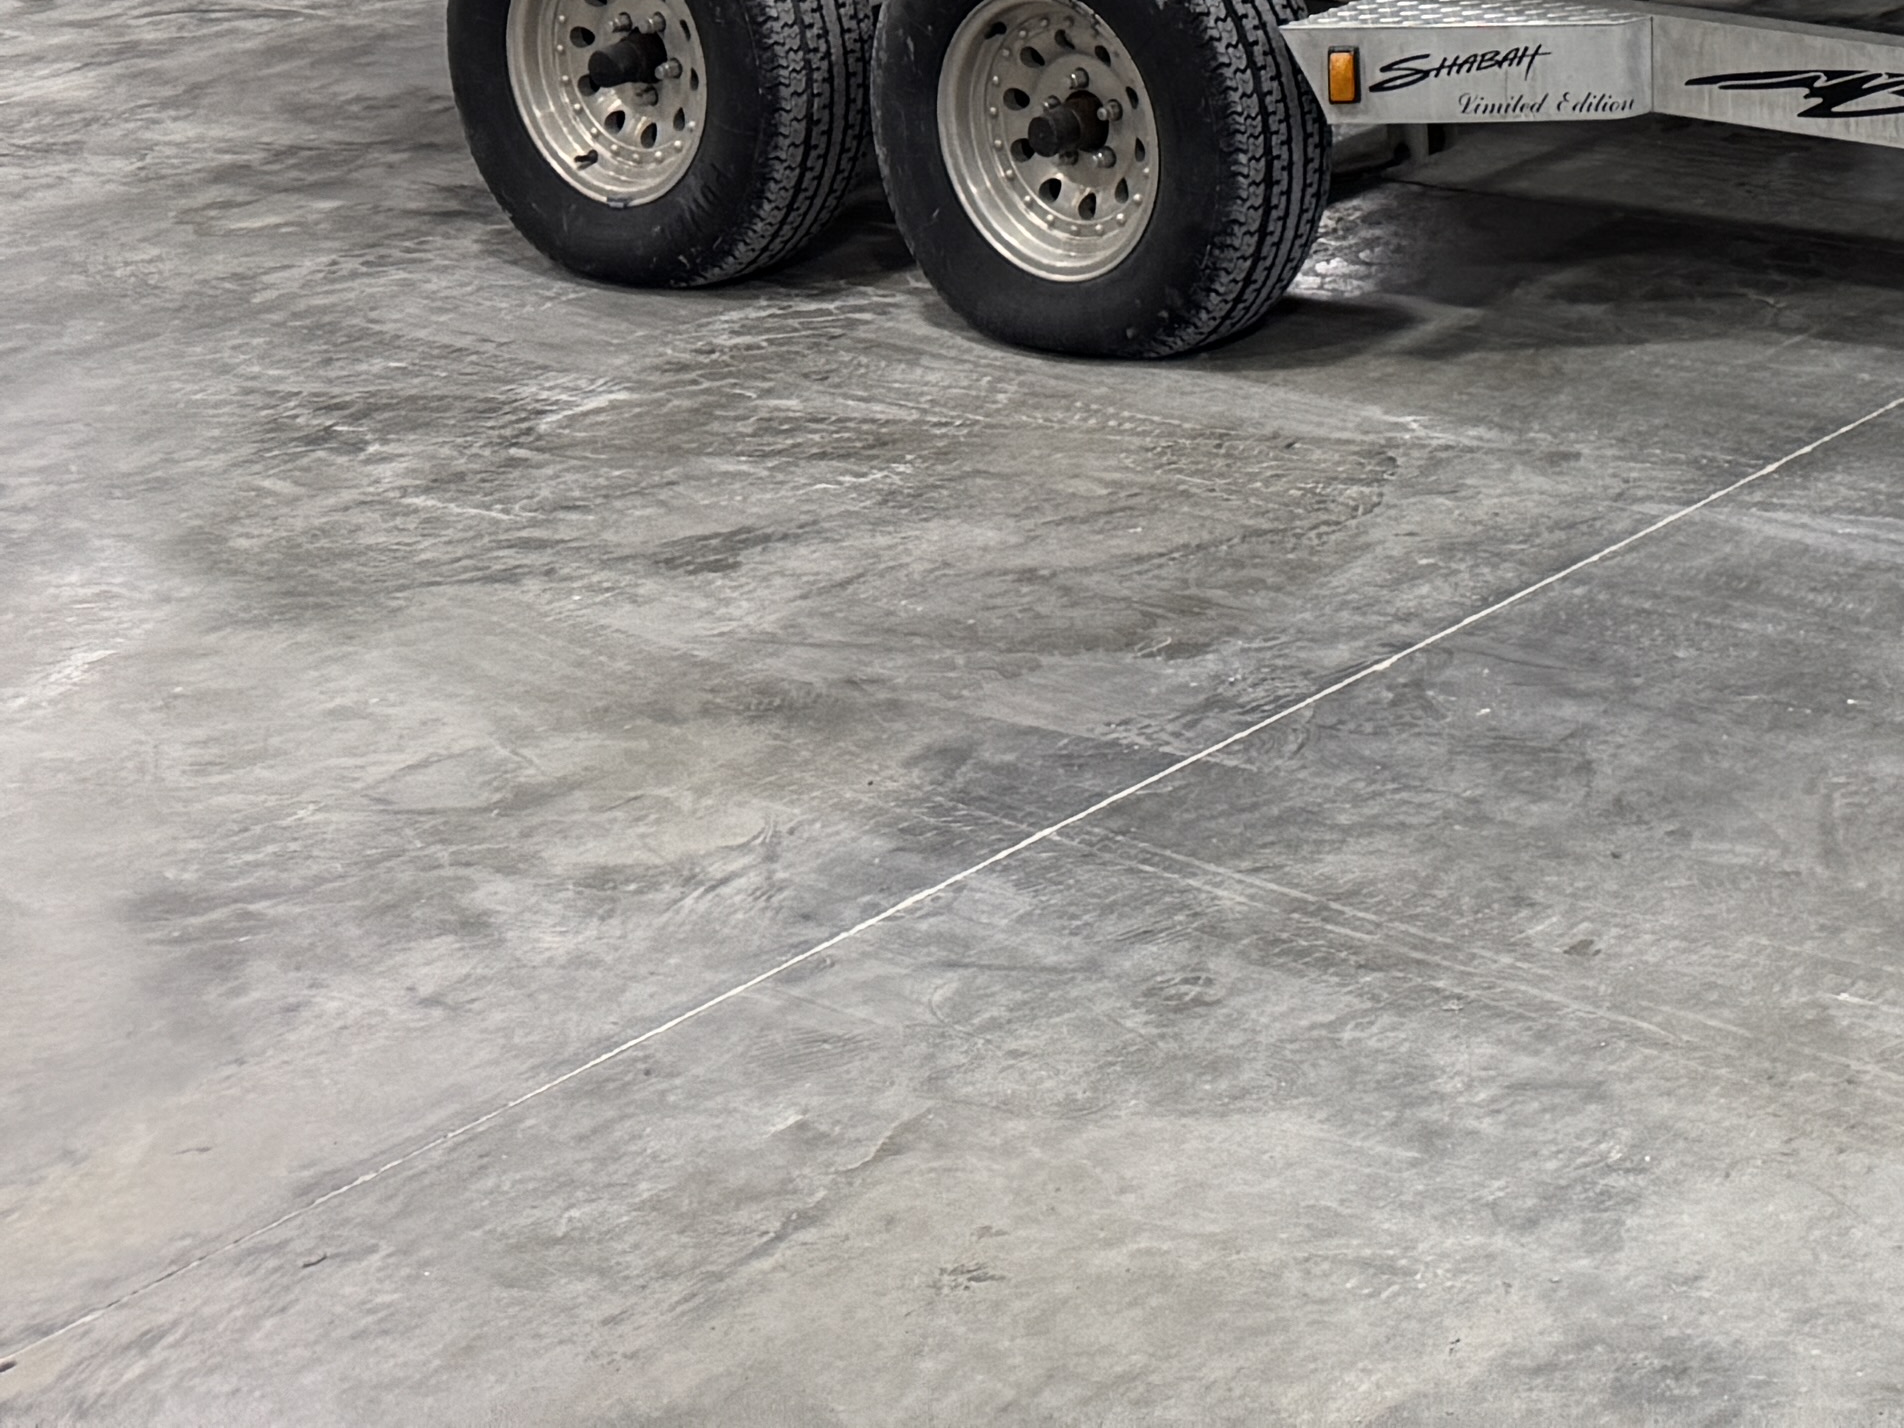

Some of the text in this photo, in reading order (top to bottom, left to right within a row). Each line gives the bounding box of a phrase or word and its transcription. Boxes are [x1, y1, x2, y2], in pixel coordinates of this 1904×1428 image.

[1368, 43, 1552, 93] SHABAH
[1457, 91, 1635, 115] Limited Edition
